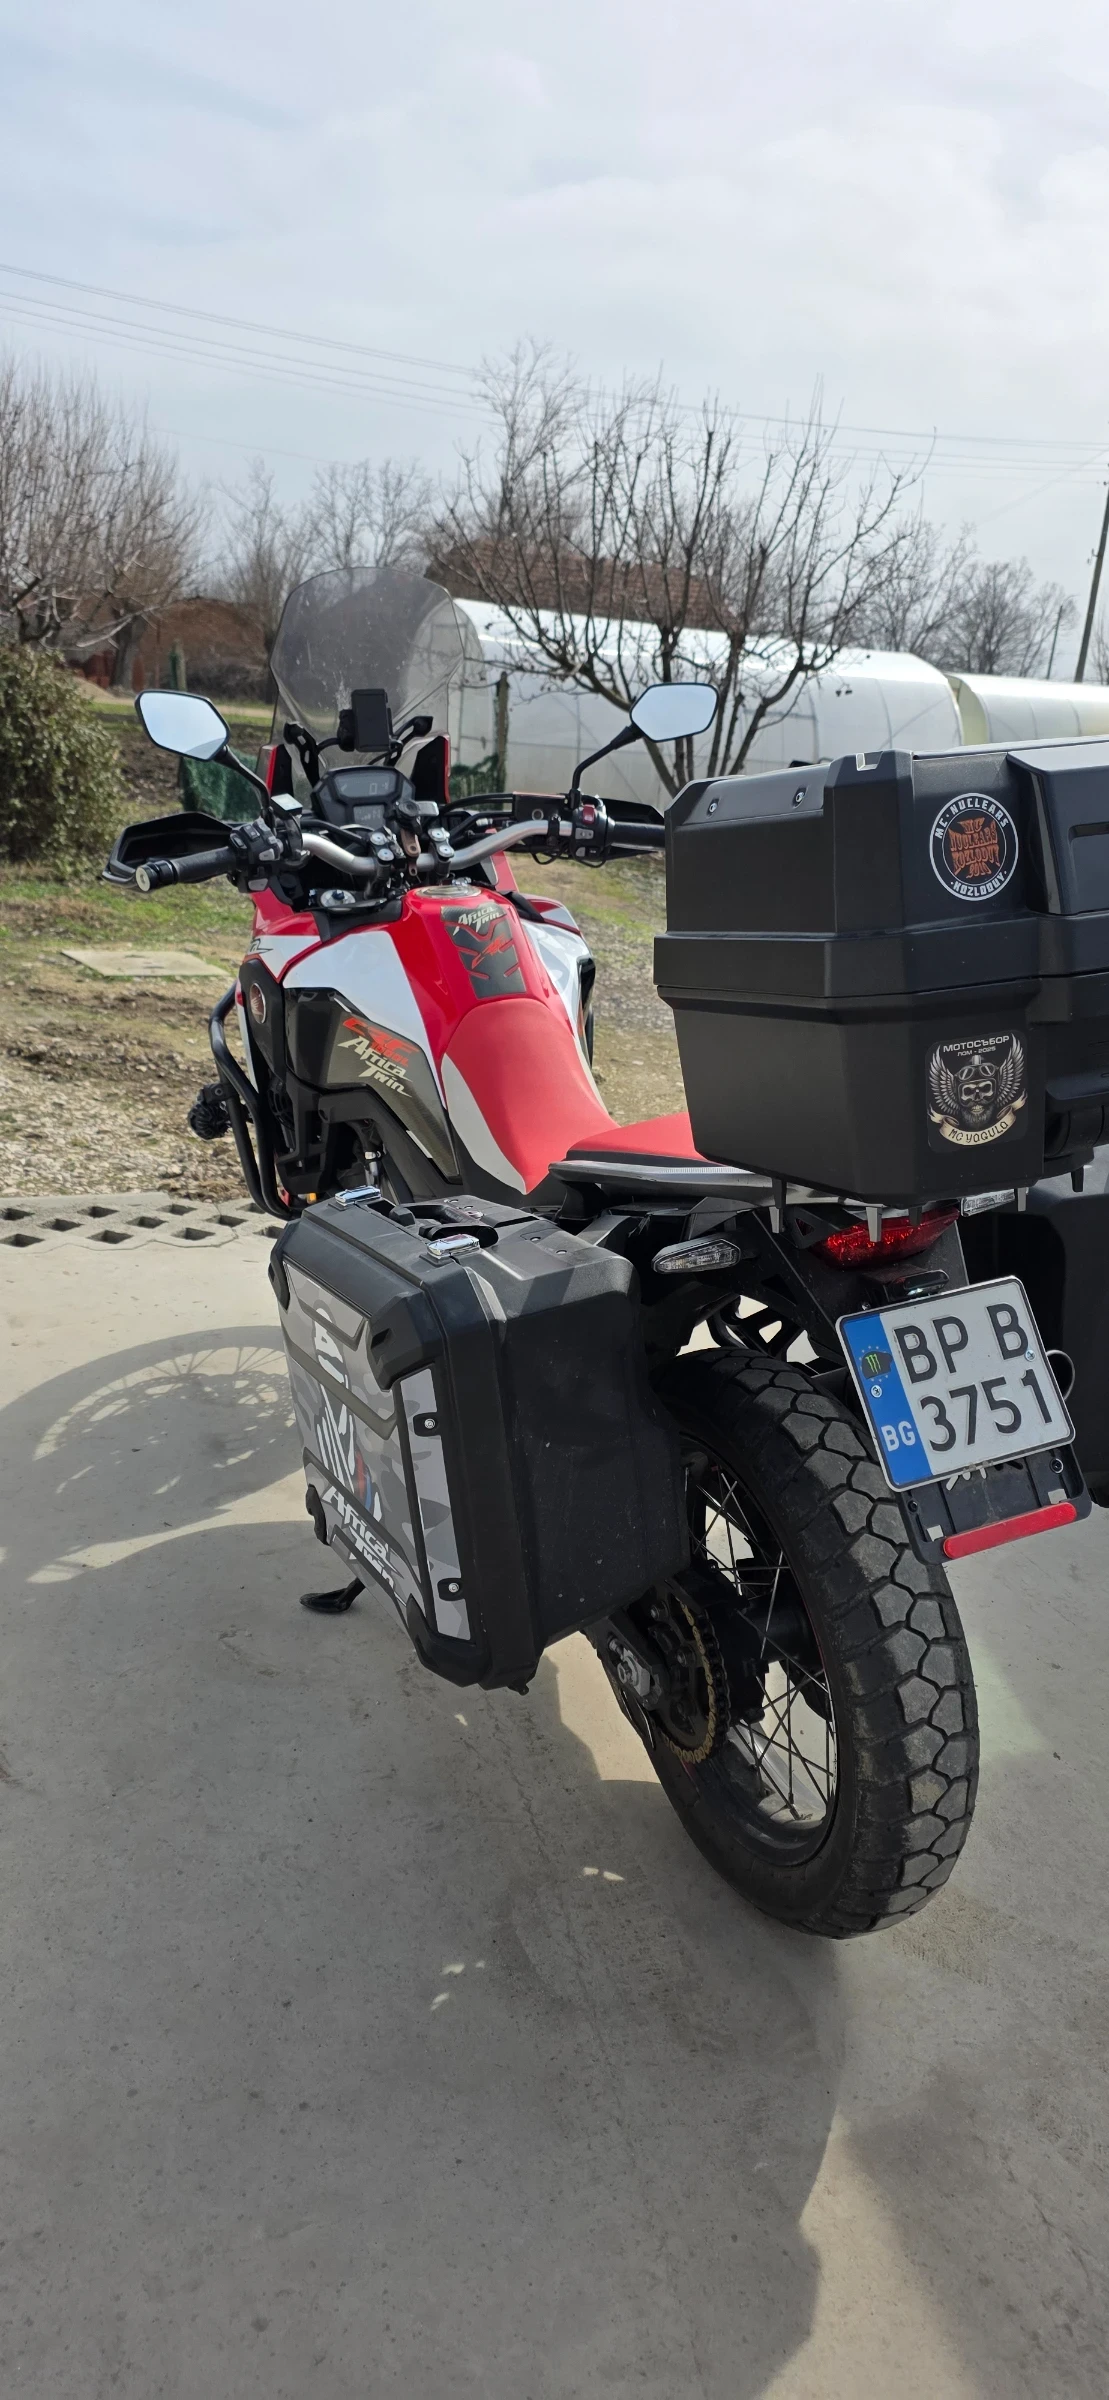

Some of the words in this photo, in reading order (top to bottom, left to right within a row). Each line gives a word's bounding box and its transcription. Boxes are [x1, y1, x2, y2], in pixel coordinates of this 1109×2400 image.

[934, 817, 948, 839] MC
[949, 798, 1009, 828] NUCLEARS
[953, 873, 1005, 897] KOZLODUY
[337, 1035, 413, 1083] Africa
[943, 1035, 1010, 1053] МОТОСЪБОР
[358, 1060, 412, 1097] Twin
[893, 1315, 969, 1385] BP
[986, 1302, 1029, 1361] B
[919, 1368, 1053, 1452] 3751
[880, 1420, 917, 1452] BG
